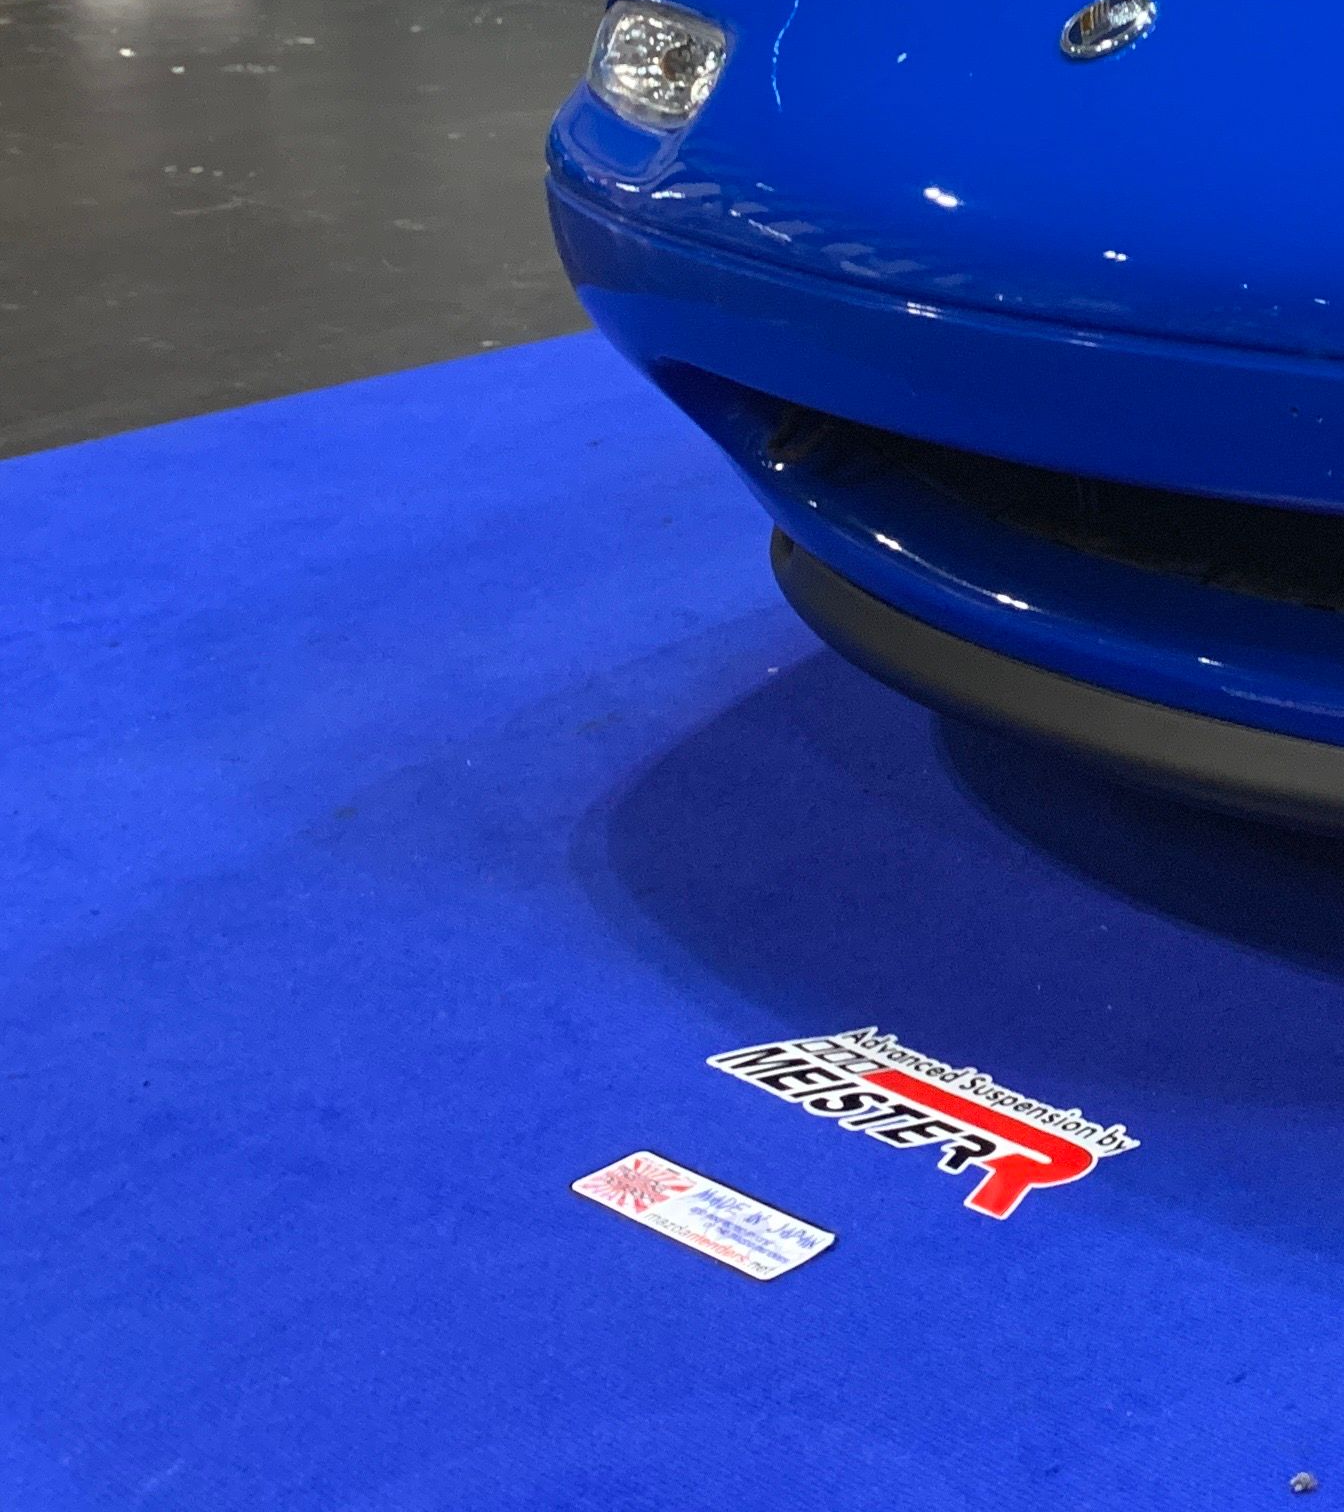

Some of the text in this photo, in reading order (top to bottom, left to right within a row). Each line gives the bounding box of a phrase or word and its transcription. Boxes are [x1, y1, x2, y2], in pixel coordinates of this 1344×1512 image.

[845, 1028, 1131, 1154] Advanced Suspension by
